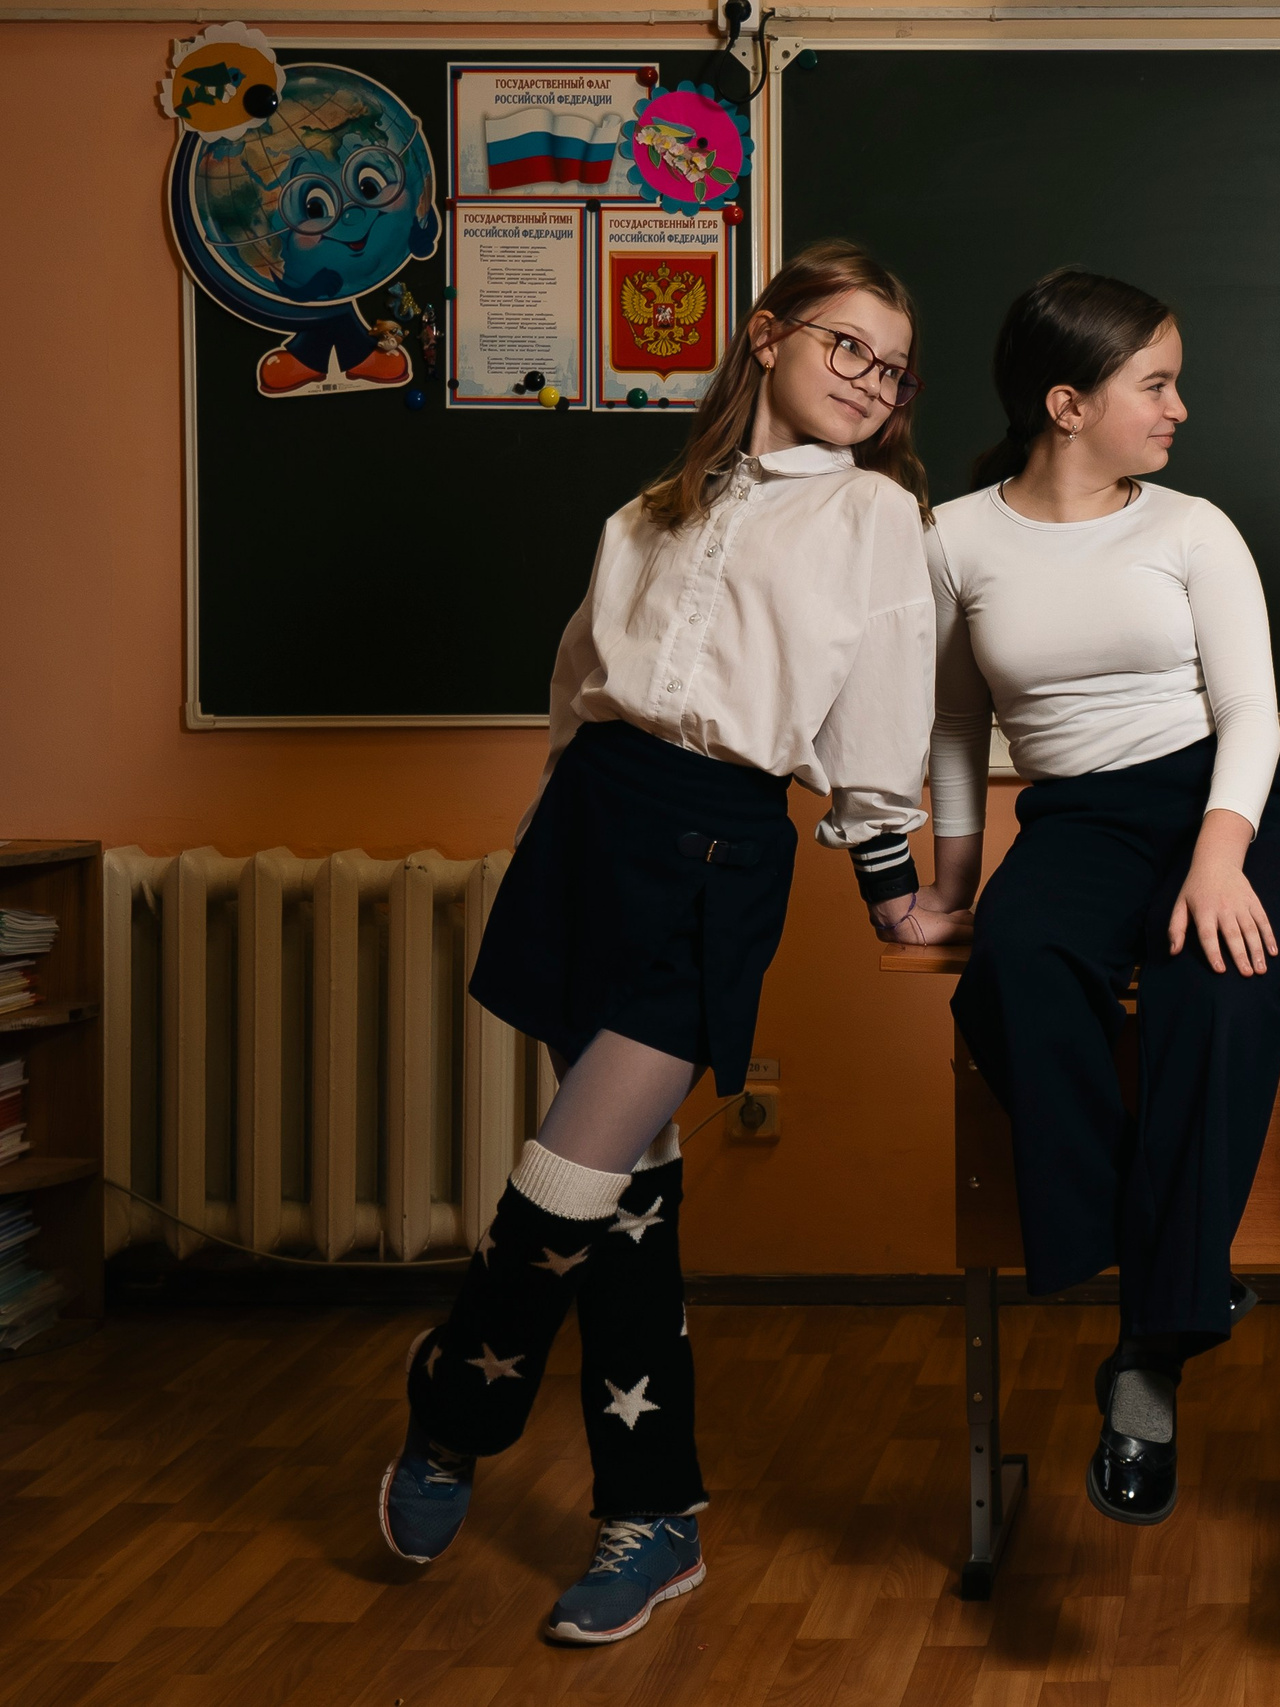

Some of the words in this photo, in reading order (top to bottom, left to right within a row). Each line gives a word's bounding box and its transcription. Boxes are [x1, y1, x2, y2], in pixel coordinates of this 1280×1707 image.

[495, 76, 585, 90] ГОСУДАРСТВЕННЫЙ
[587, 78, 611, 89] ФЛАГ
[495, 92, 555, 105] РОССИЙСКОЙ
[557, 94, 612, 107] ФЕДЕРАЦИИ
[464, 212, 548, 225] ГОСУДАРСТВЕННЫЙ
[549, 214, 573, 225] ГИМН
[609, 216, 695, 230] ГОСУДАРСТВЕННЫЙ
[697, 219, 719, 230] ГЕРБ
[463, 226, 520, 239] РОССИЙСКОЙ
[522, 228, 574, 241] ФЕДЕРАЦИИ
[609, 231, 665, 244] РОССИЙСКОЙ
[667, 233, 719, 246] ФЕДЕРАЦИИ
[749, 1063, 760, 1072] 20
